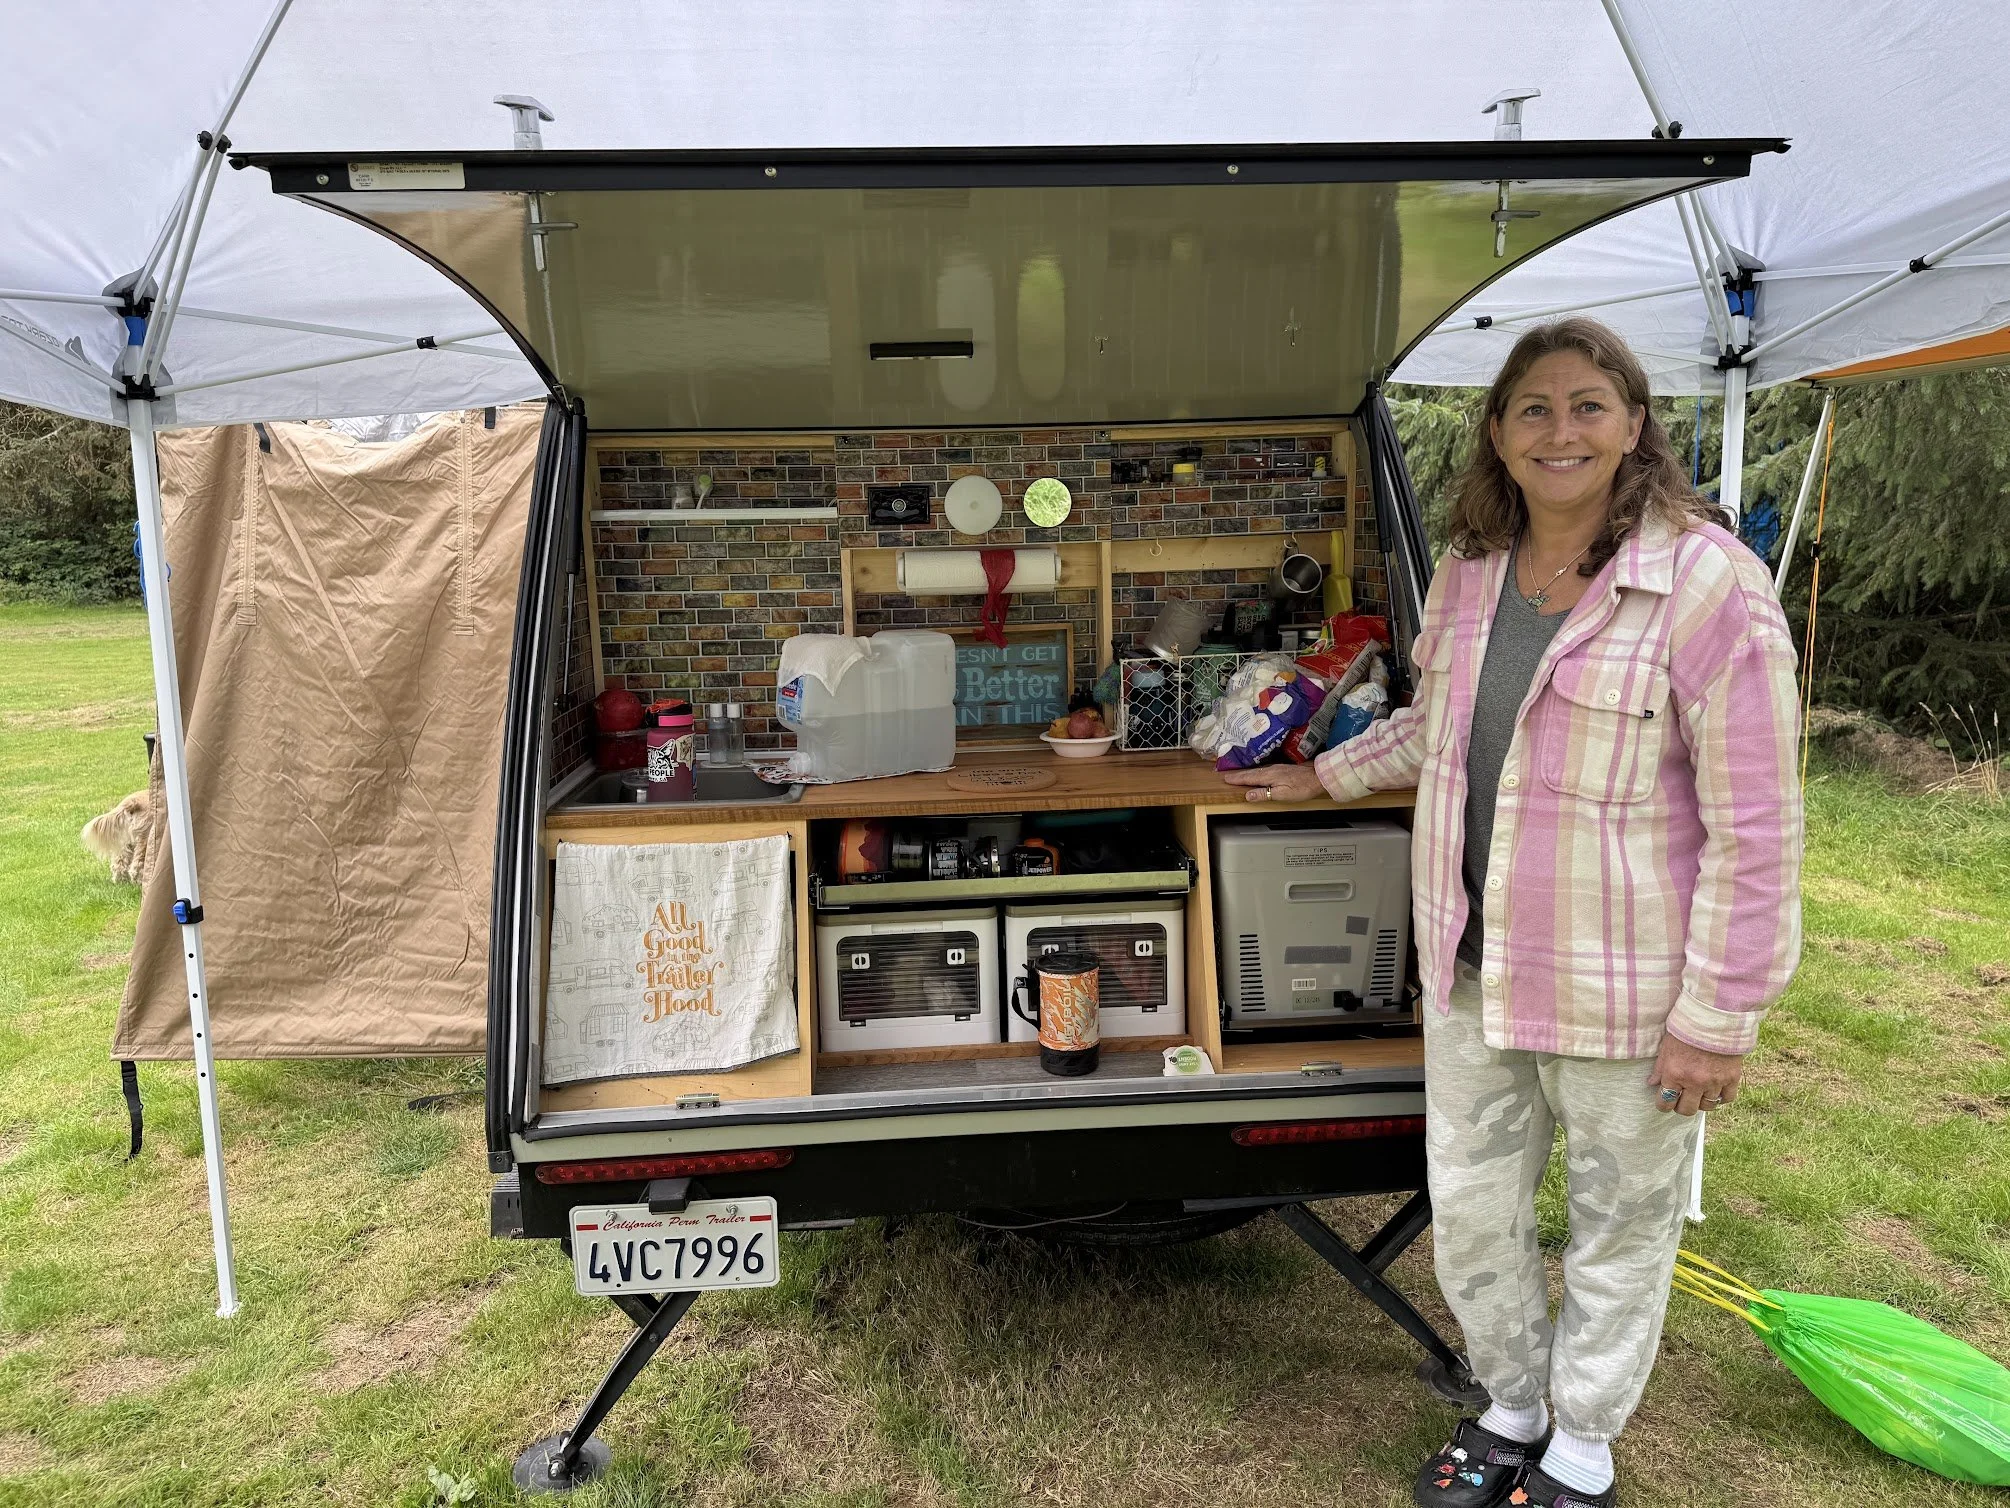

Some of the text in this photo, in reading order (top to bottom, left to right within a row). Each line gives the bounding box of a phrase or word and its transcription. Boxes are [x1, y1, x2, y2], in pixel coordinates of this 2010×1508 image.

[956, 646, 1060, 663] ESN'T GET
[962, 667, 1060, 702] Better
[998, 703, 1060, 724] THIS
[650, 900, 697, 934] All
[643, 920, 713, 959] Good
[636, 960, 724, 990] Trailer
[643, 988, 722, 1023] Hood
[603, 1214, 746, 1231] California Perm Trailer
[589, 1232, 764, 1282] 4VC7996
